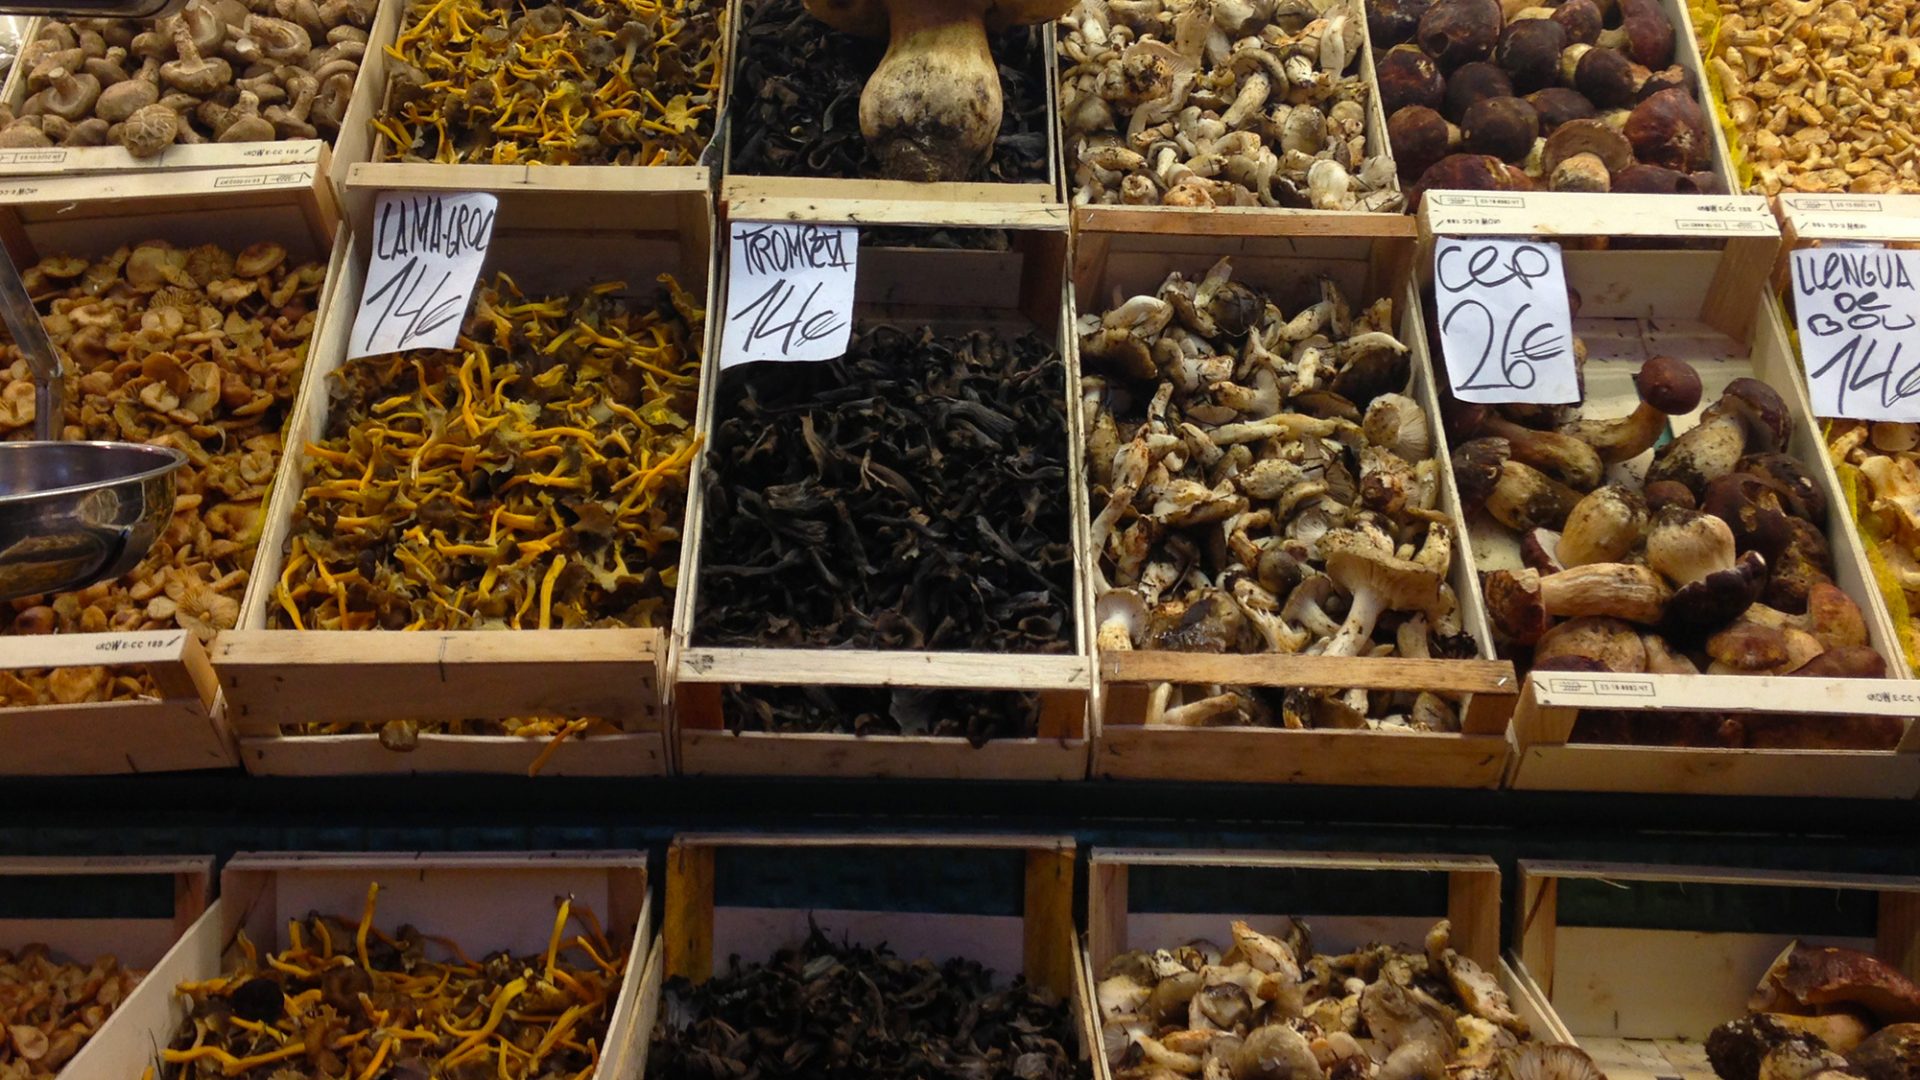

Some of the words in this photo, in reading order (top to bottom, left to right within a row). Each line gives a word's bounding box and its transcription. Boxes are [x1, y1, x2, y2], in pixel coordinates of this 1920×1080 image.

[366, 256, 462, 352] 14€
[731, 278, 847, 356] 14€
[1442, 299, 1566, 390] 26€
[1807, 313, 1916, 337] BOU
